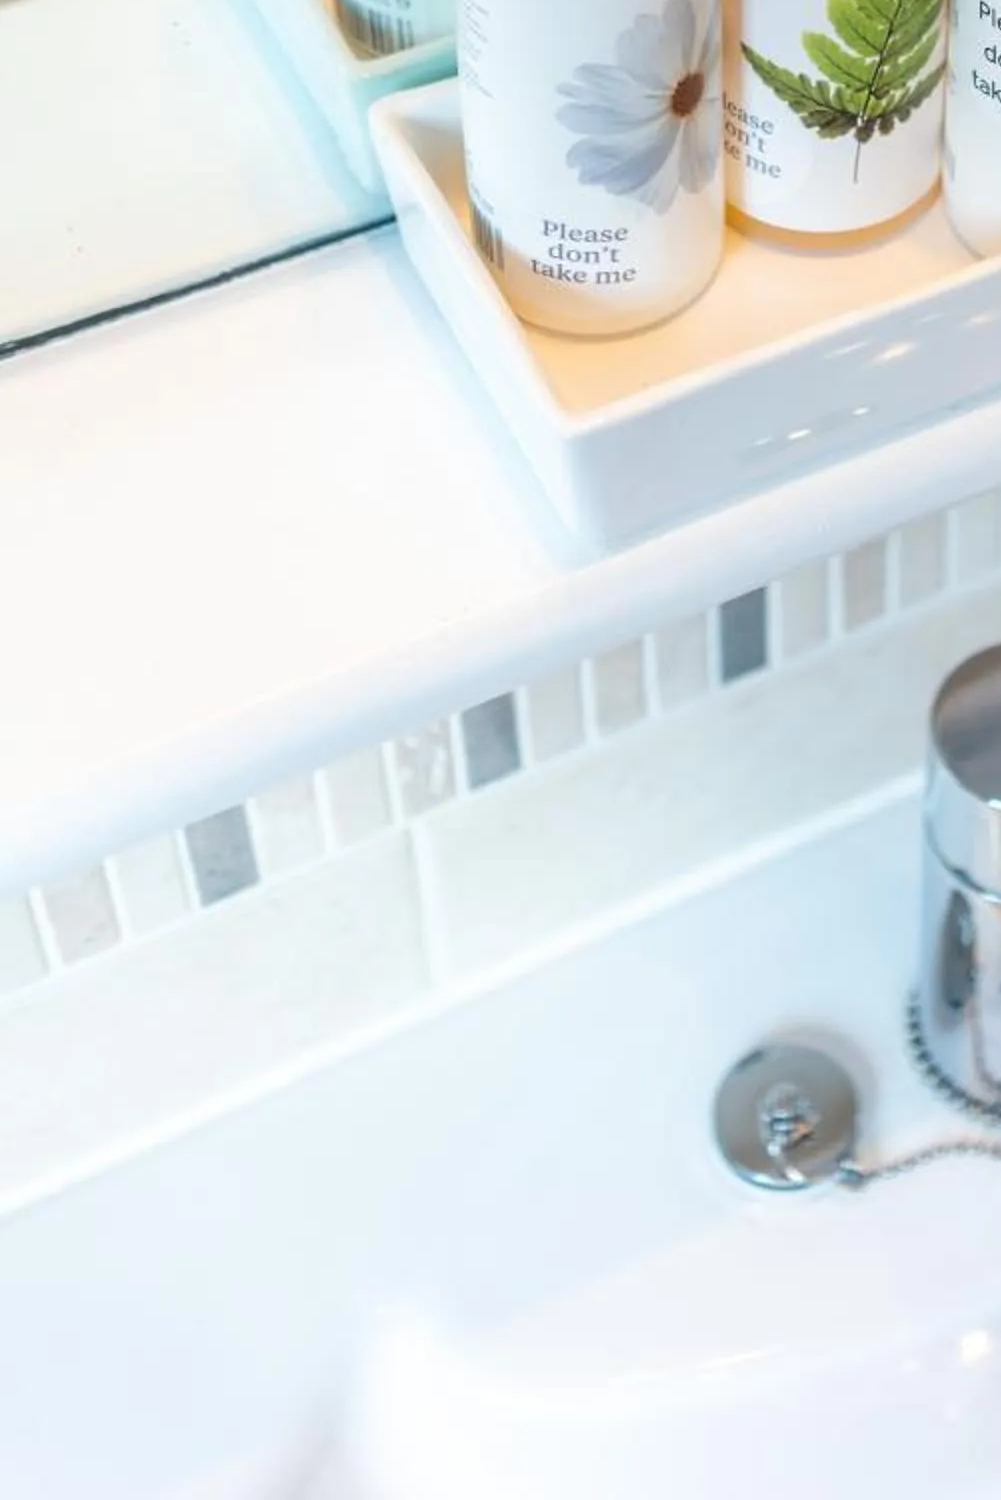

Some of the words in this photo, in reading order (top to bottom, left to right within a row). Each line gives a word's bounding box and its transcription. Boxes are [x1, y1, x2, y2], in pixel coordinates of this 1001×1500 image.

[722, 91, 775, 136] lease
[724, 120, 765, 154] on't
[746, 154, 782, 179] me
[543, 219, 629, 244] Please
[548, 243, 621, 264] don't
[530, 258, 588, 285] take
[595, 267, 637, 285] me
